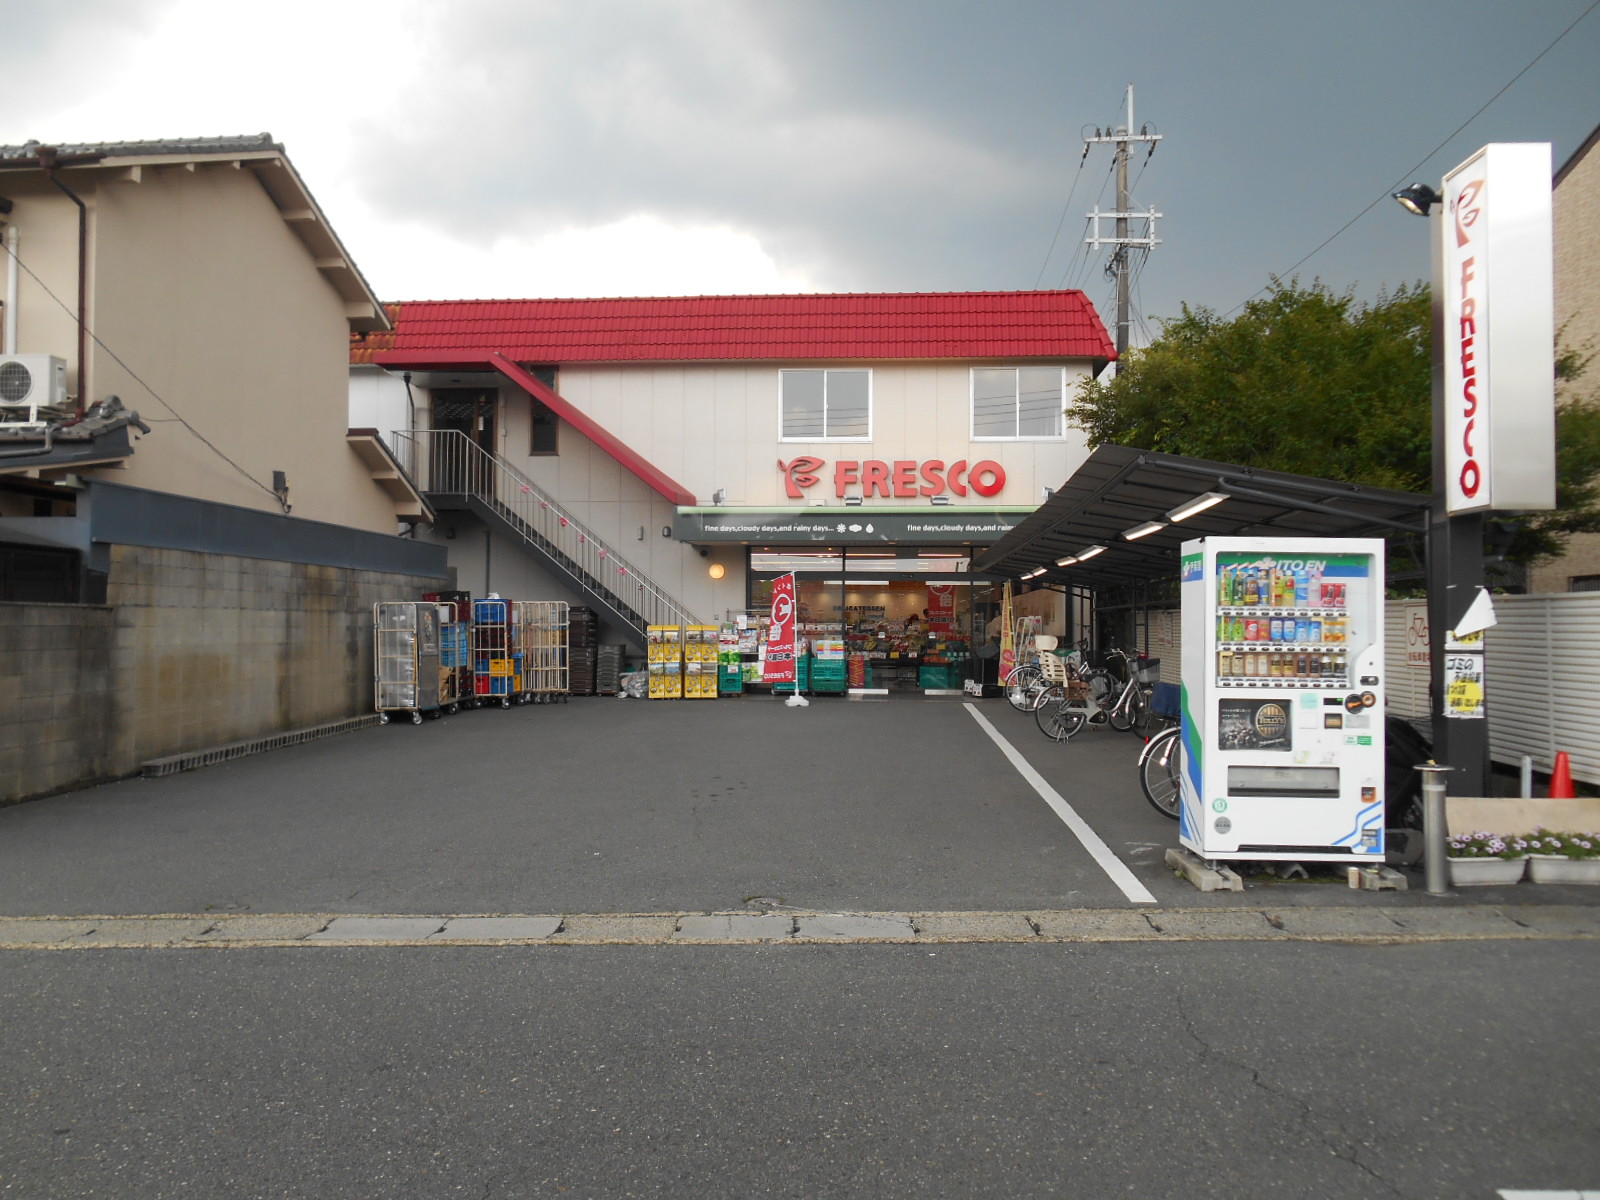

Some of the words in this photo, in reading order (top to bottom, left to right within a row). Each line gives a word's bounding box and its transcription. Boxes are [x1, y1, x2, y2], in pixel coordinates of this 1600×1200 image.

[1460, 256, 1480, 498] FRESCO
[834, 459, 1007, 498] FRESCO
[1276, 560, 1304, 571] ITO
[1304, 560, 1326, 571] EN
